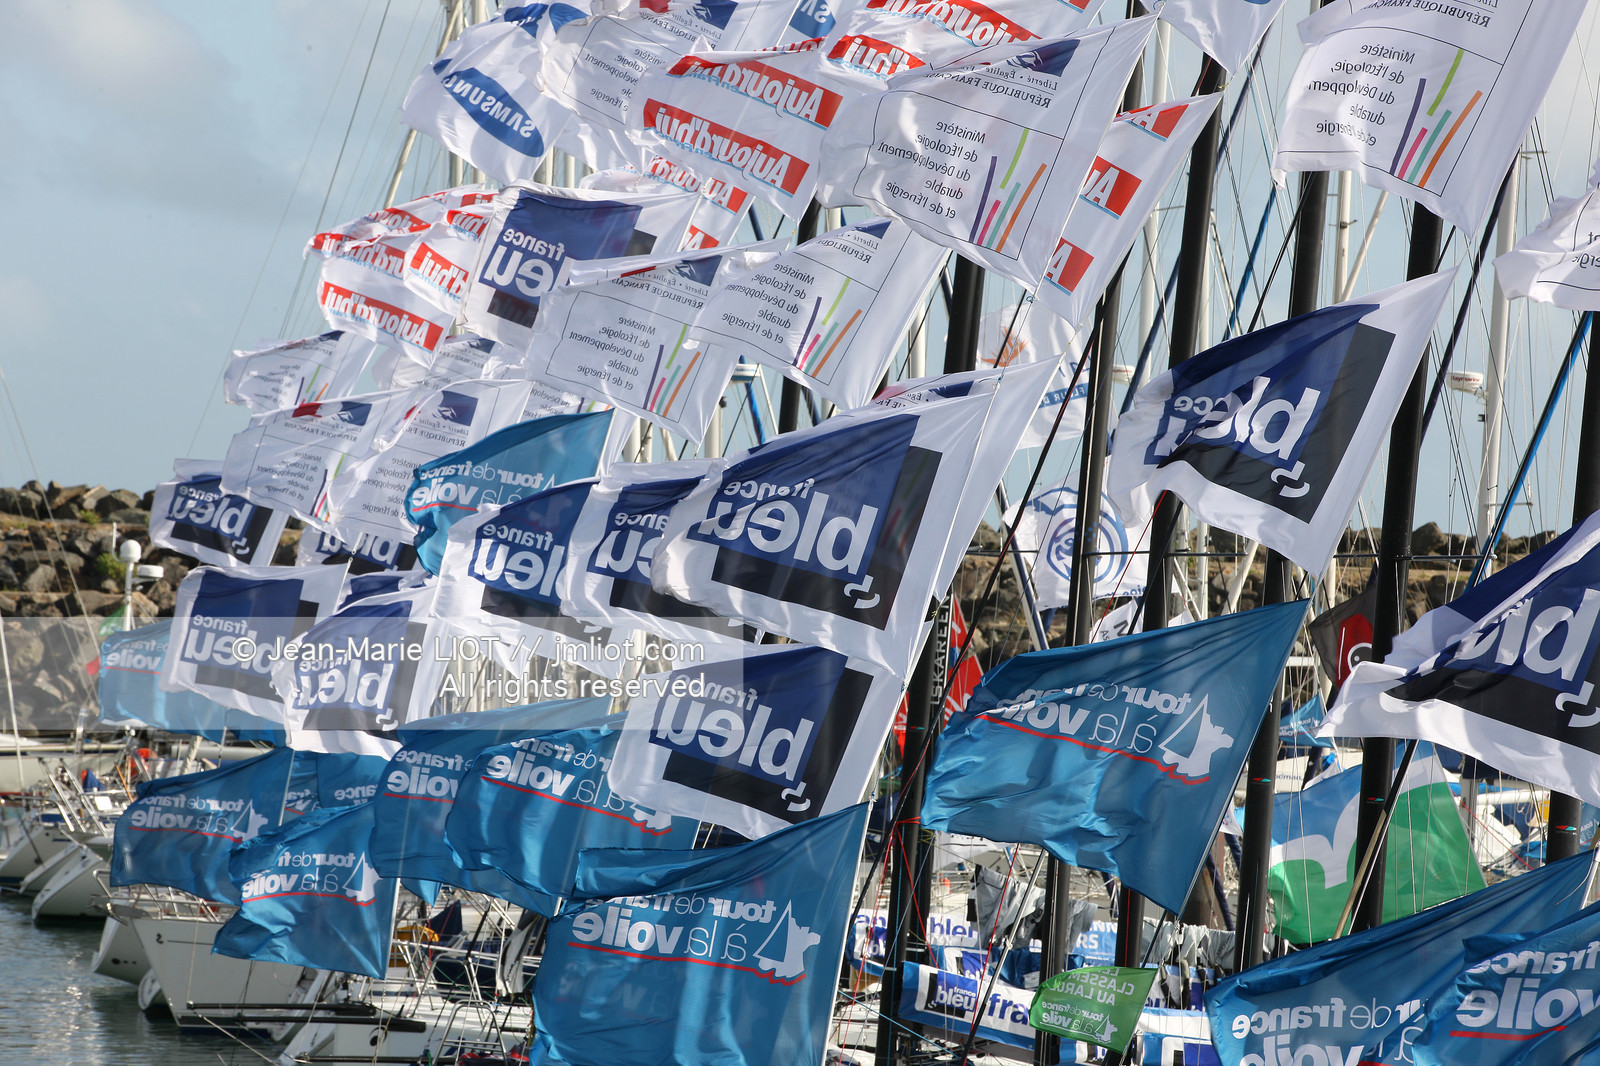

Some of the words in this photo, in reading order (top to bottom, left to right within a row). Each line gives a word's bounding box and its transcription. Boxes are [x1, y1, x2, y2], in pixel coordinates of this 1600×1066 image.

[936, 986, 976, 1012] bleu
[954, 986, 976, 998] france
[988, 993, 1028, 1025] fra
